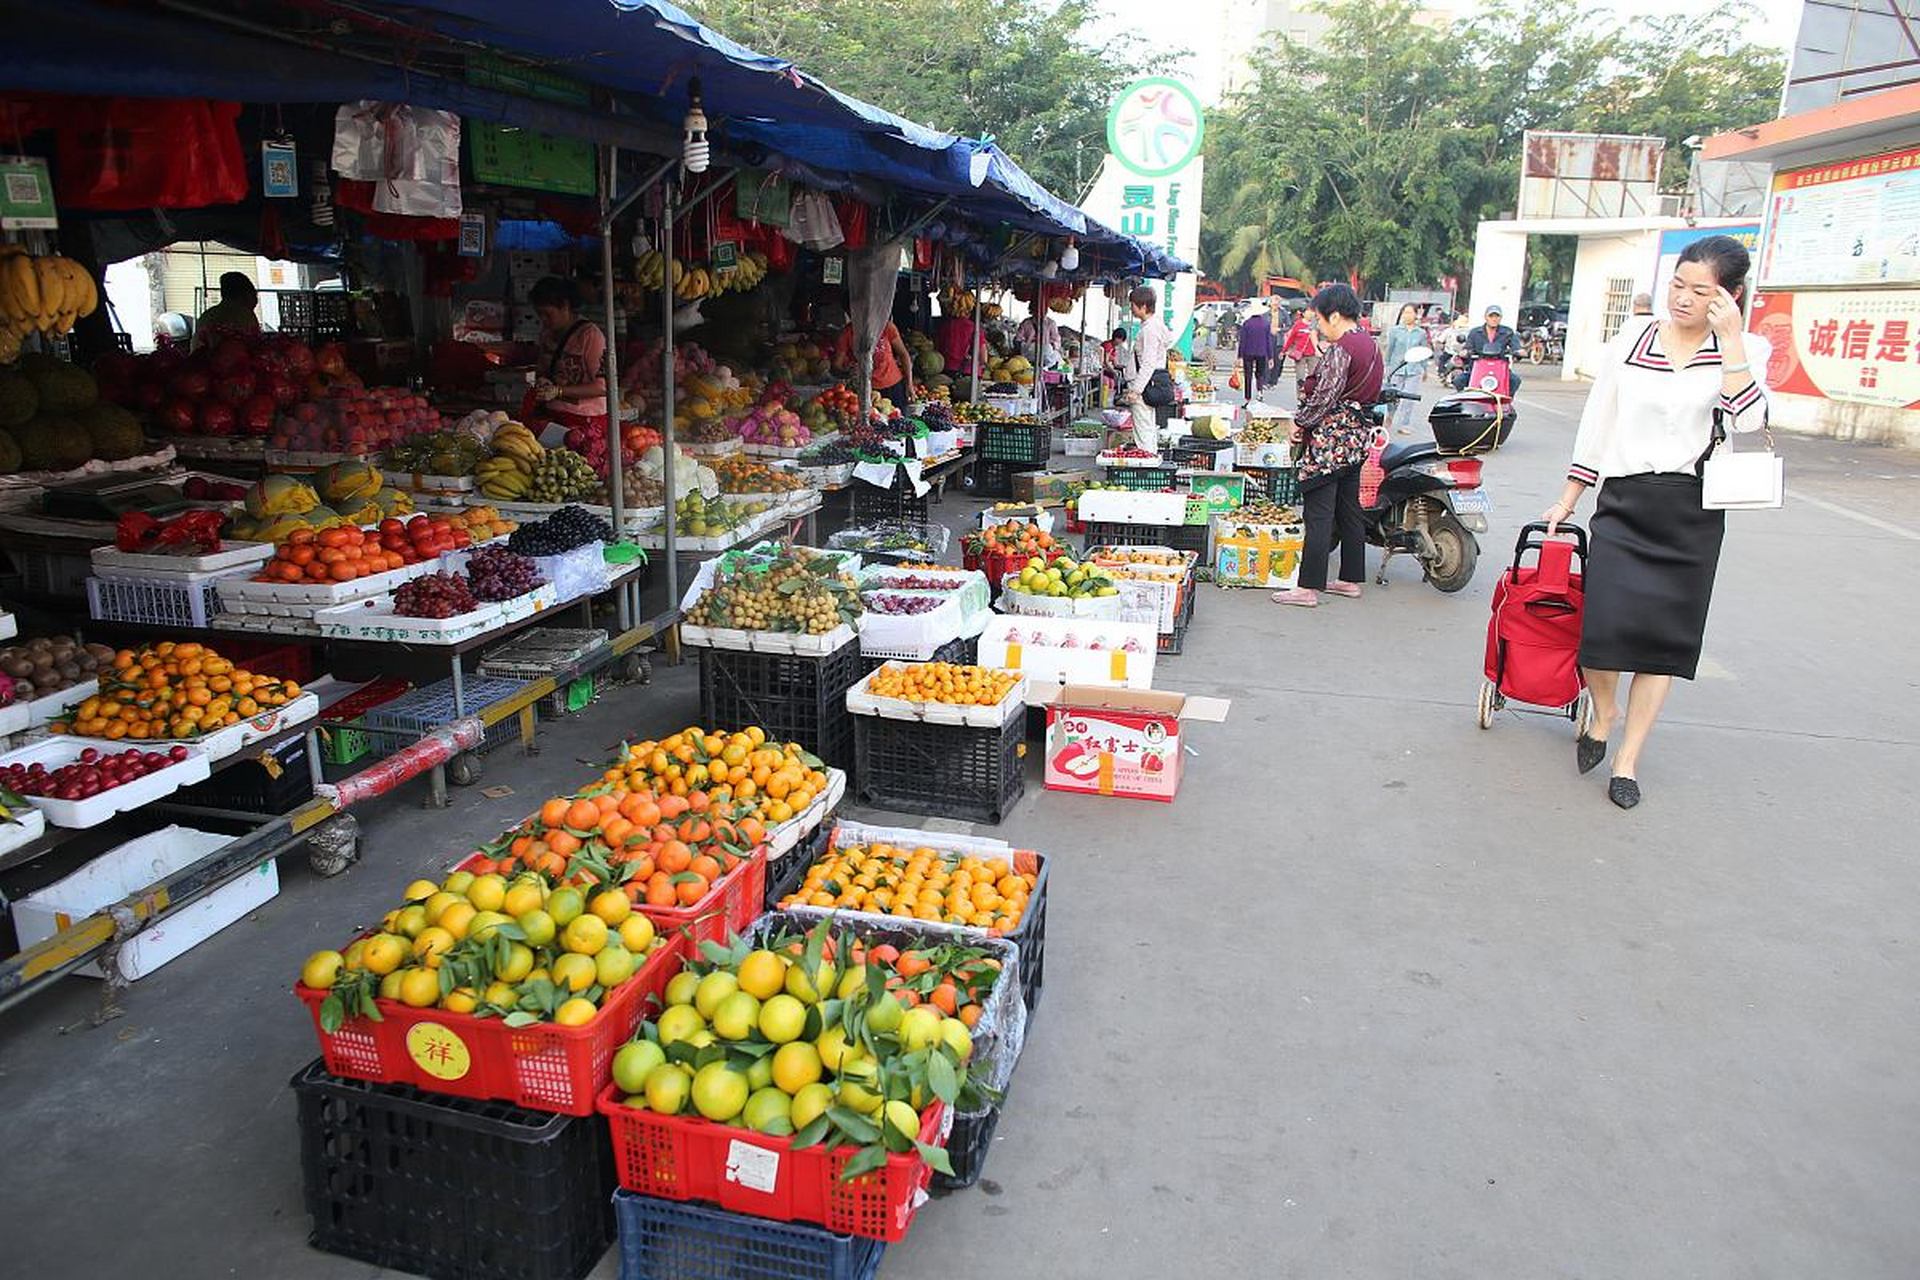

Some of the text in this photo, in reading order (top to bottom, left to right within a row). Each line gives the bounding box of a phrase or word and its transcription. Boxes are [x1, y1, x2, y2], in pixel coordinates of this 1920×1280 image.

[1085, 735, 1139, 753] 红富士
[424, 1036, 455, 1067] 祥
